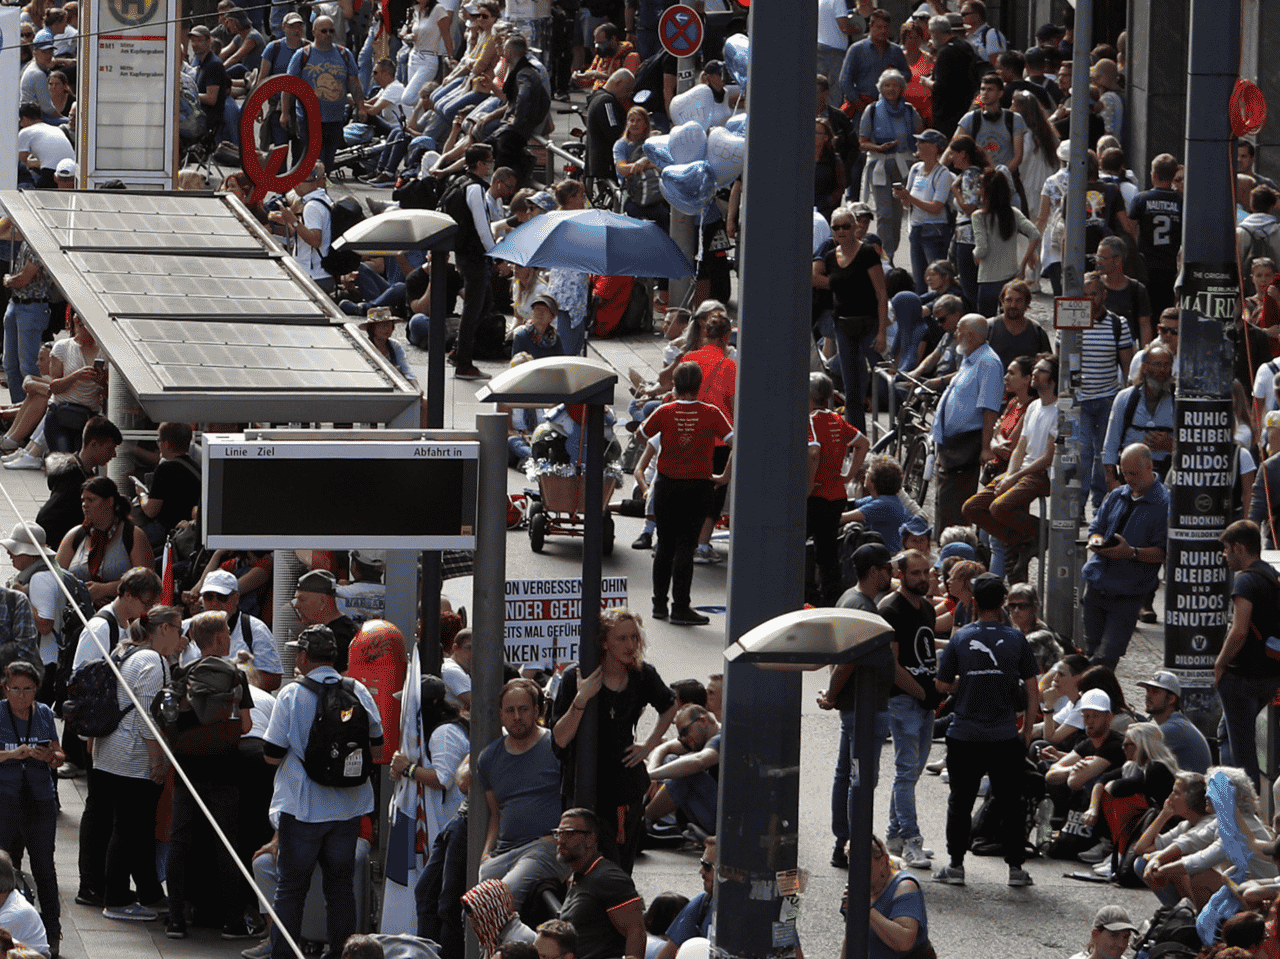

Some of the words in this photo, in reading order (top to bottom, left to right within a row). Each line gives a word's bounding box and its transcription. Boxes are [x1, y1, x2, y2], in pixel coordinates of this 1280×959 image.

[1145, 199, 1178, 213] NAUTICAL
[1152, 214, 1171, 246] 2
[1184, 411, 1228, 427] RUHIG
[1179, 428, 1231, 443] BLEIBEN
[225, 447, 247, 456] Linie
[257, 447, 275, 457] Ziel
[413, 447, 450, 457] Abfahrt
[452, 447, 462, 457] in
[1182, 454, 1229, 469] DILDOS
[1179, 551, 1224, 566] RUHIG
[1174, 568, 1227, 583] BLEIBEN
[504, 580, 520, 596] ON
[601, 578, 627, 593] OHIN
[504, 600, 543, 620] NDER
[1177, 596, 1224, 610] DILDOS
[524, 625, 545, 638] MAL
[1176, 655, 1215, 665] DILDOKIN
